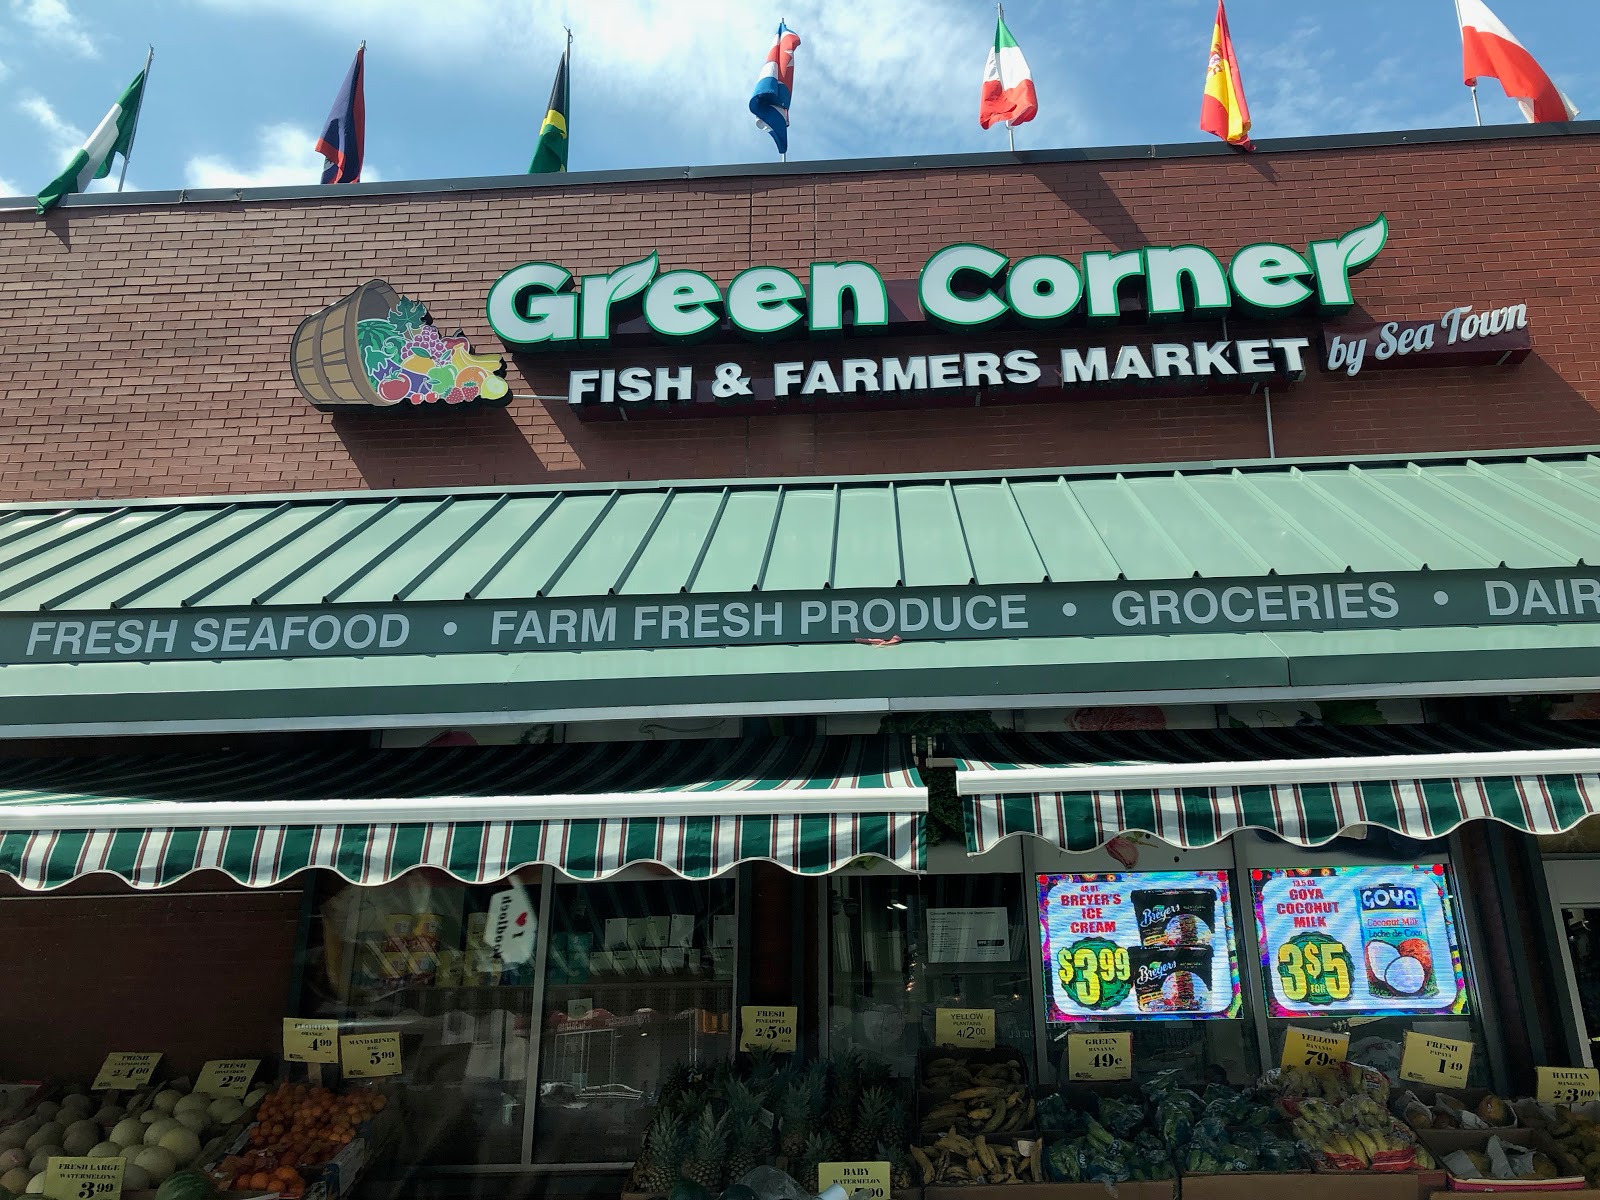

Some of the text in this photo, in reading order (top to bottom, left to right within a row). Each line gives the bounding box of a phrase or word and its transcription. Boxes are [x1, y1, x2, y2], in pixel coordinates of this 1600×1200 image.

[486, 212, 1388, 343] Green Corner
[1329, 303, 1528, 377] by Sea Town
[568, 338, 1309, 404] FISH & FARMERS MARKET
[1112, 581, 1399, 626] GROCERIES
[1485, 577, 1600, 616] DAIR
[491, 594, 1028, 645] FARM FRESH PRODUCE
[26, 613, 410, 656] FRESH SEAFOOD
[1061, 894, 1121, 906] BREYER'S
[1289, 888, 1324, 900] GOYA
[1362, 888, 1417, 908] GOYA
[1082, 908, 1102, 919] ICE
[1140, 904, 1180, 927] Breyers
[1277, 901, 1339, 914] COCONUT
[1070, 922, 1116, 933] CREAM
[1294, 916, 1326, 928] MILK
[1367, 918, 1419, 926] Coconut Milk
[1137, 961, 1177, 984] Breyers
[1301, 1034, 1338, 1045] YELLOW
[1426, 1040, 1458, 1052] FRESH
